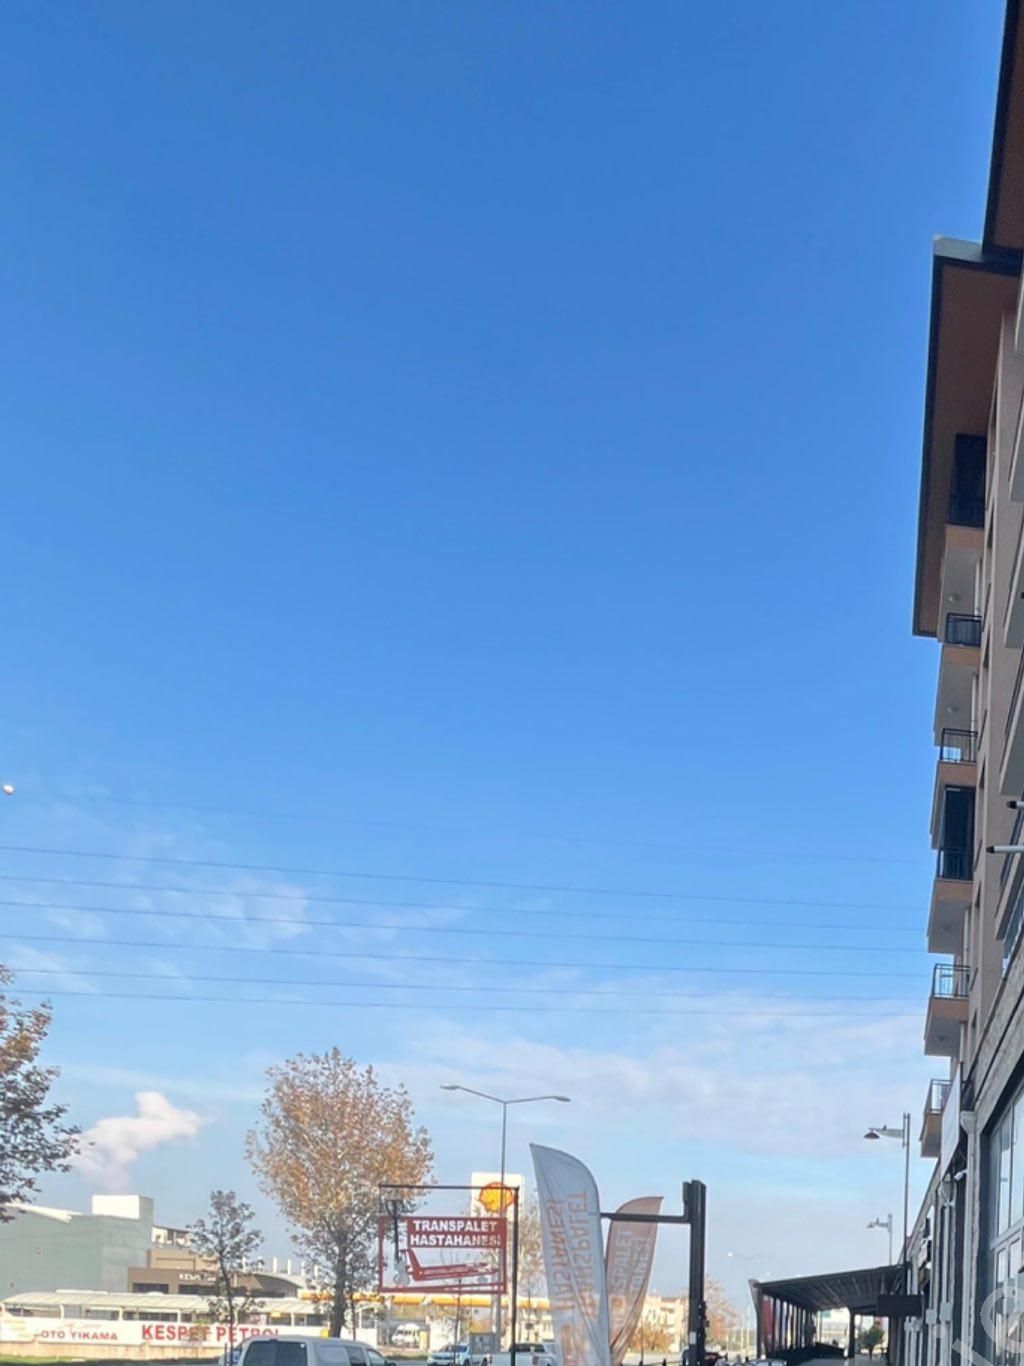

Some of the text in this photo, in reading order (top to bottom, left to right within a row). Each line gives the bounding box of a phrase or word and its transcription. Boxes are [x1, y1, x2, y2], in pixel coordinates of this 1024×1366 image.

[413, 1220, 497, 1232] TRANSPALET
[41, 1330, 65, 1339] OTO
[142, 1325, 211, 1341] KESPET
